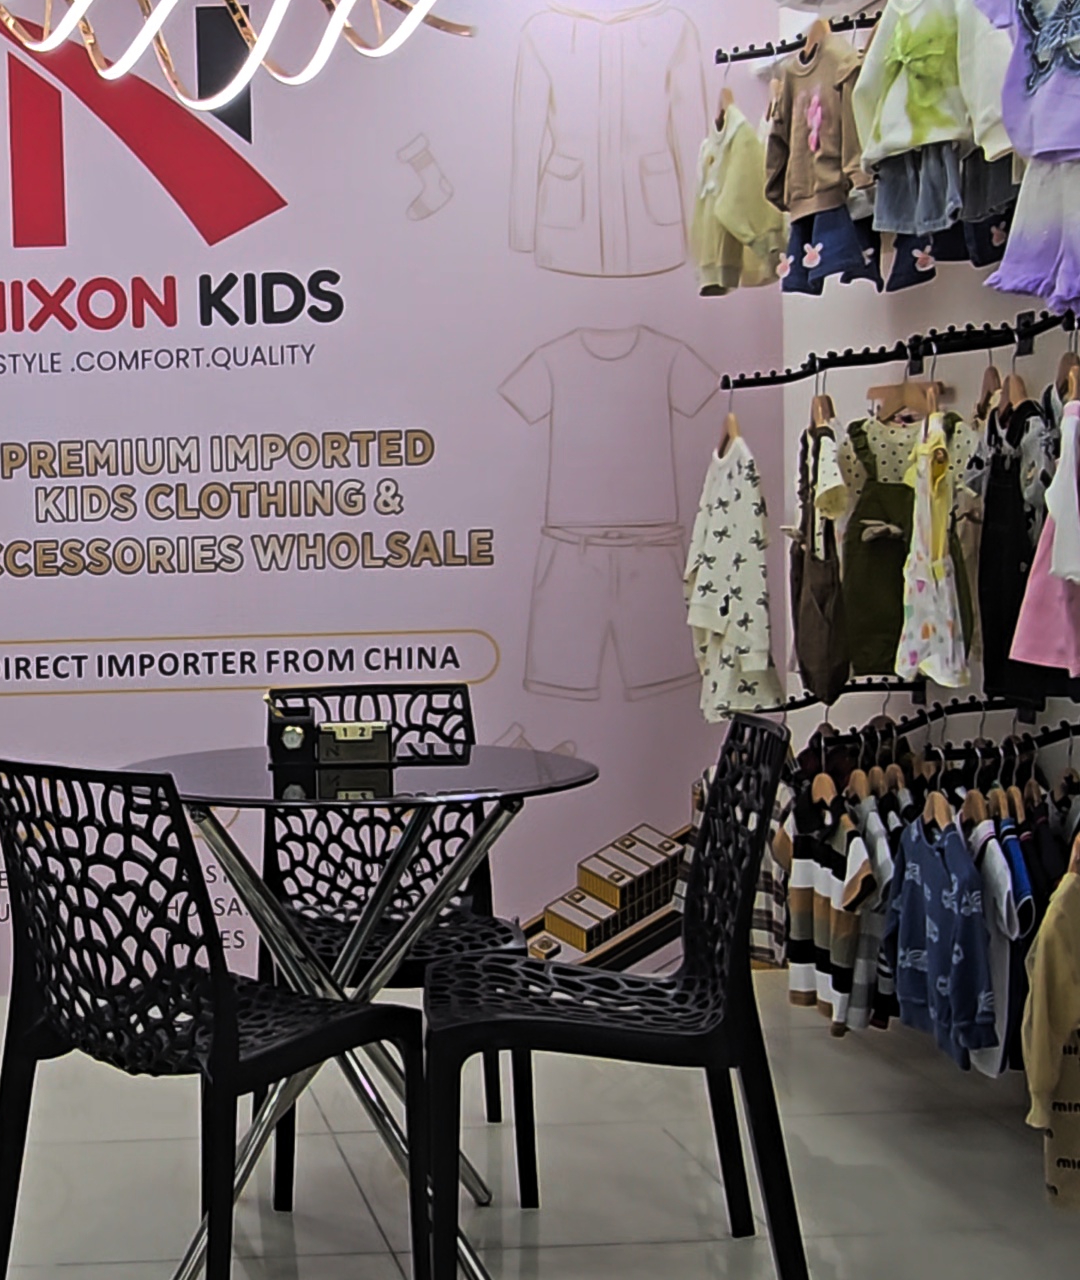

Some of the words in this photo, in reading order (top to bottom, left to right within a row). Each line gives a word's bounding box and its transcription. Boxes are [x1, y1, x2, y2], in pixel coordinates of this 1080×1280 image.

[199, 269, 345, 327] KIDS
[0, 436, 201, 480] PREMIUM
[209, 429, 436, 472] IMPORTED
[35, 484, 138, 523] KIDS
[145, 479, 366, 521] CLOTHING
[373, 477, 405, 516] &
[250, 529, 495, 571] WHOLSALE
[96, 651, 258, 678] IMPORTER
[266, 648, 355, 674] FROM
[364, 646, 461, 671] CHINA
